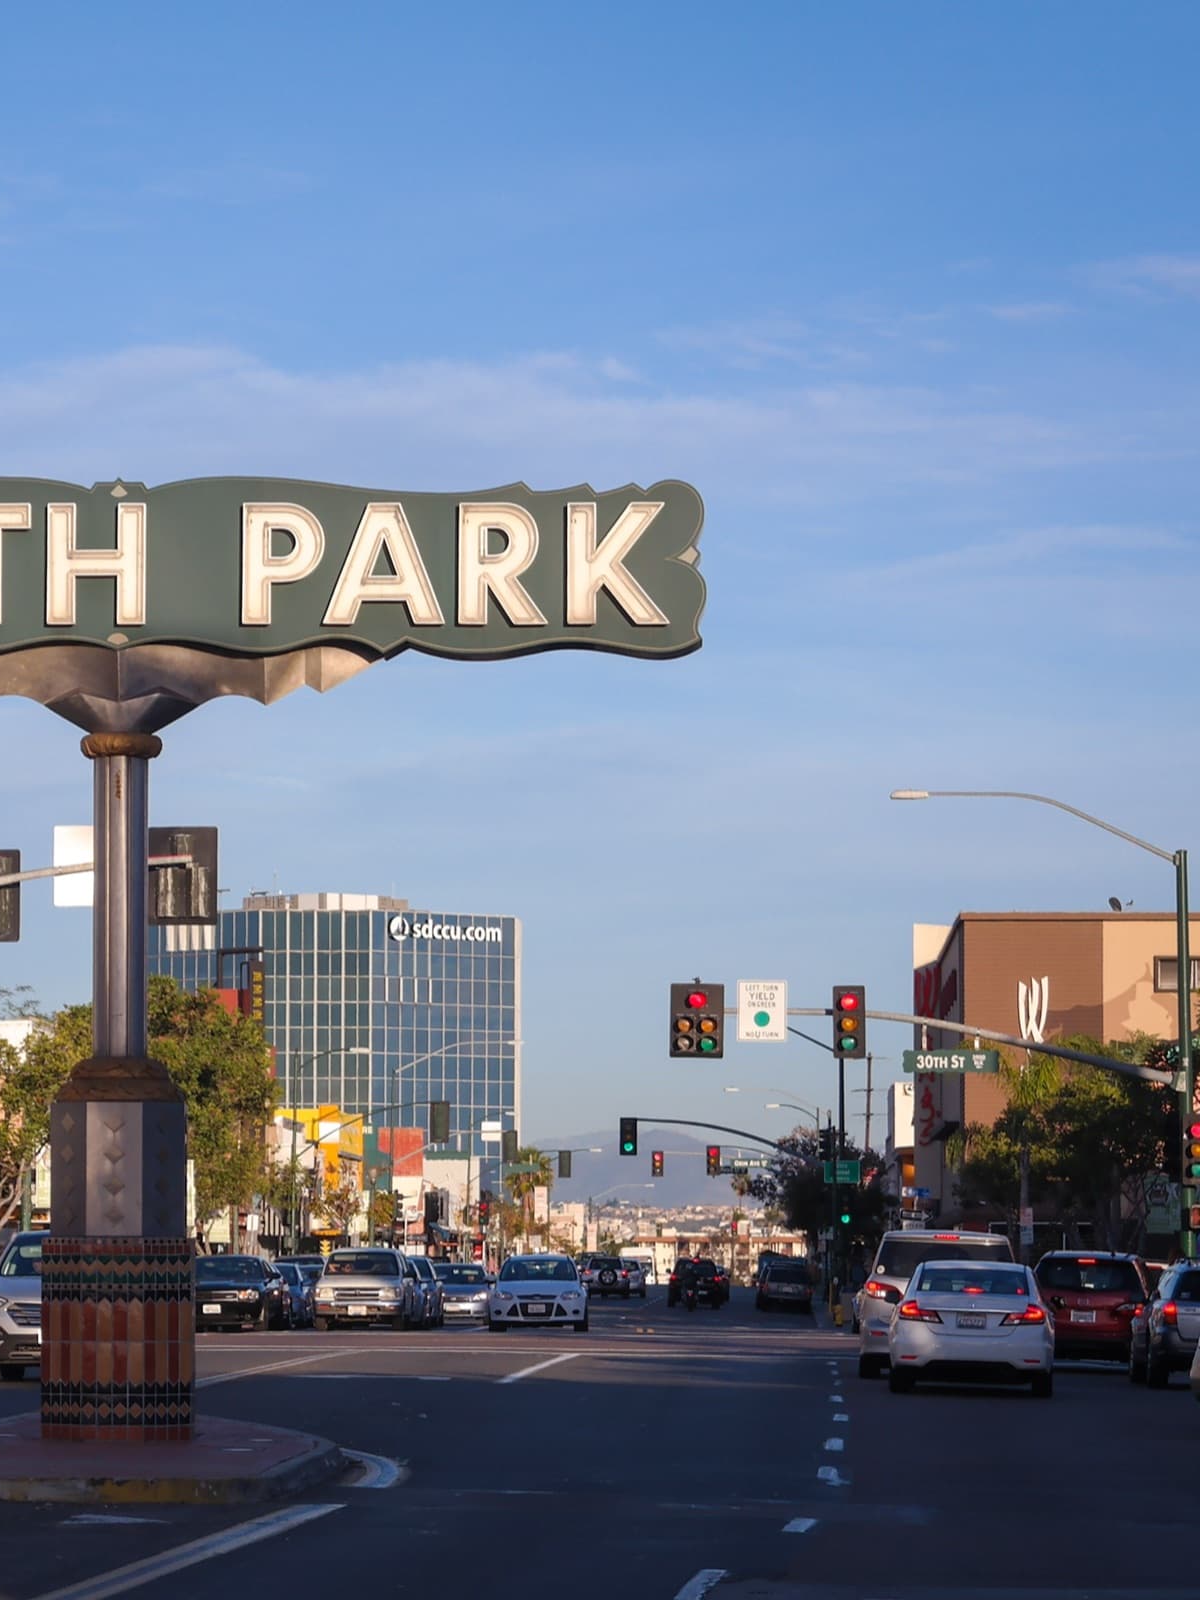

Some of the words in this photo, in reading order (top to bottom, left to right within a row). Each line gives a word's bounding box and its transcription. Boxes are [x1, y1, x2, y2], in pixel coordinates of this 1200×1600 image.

[241, 501, 670, 627] PARK
[413, 917, 502, 942] sdccu.com
[749, 992, 776, 1001] YIELD
[747, 1000, 756, 1008] ON
[757, 1000, 776, 1008] GREEN
[755, 1030, 761, 1039] U
[916, 1054, 948, 1069] 30TH
